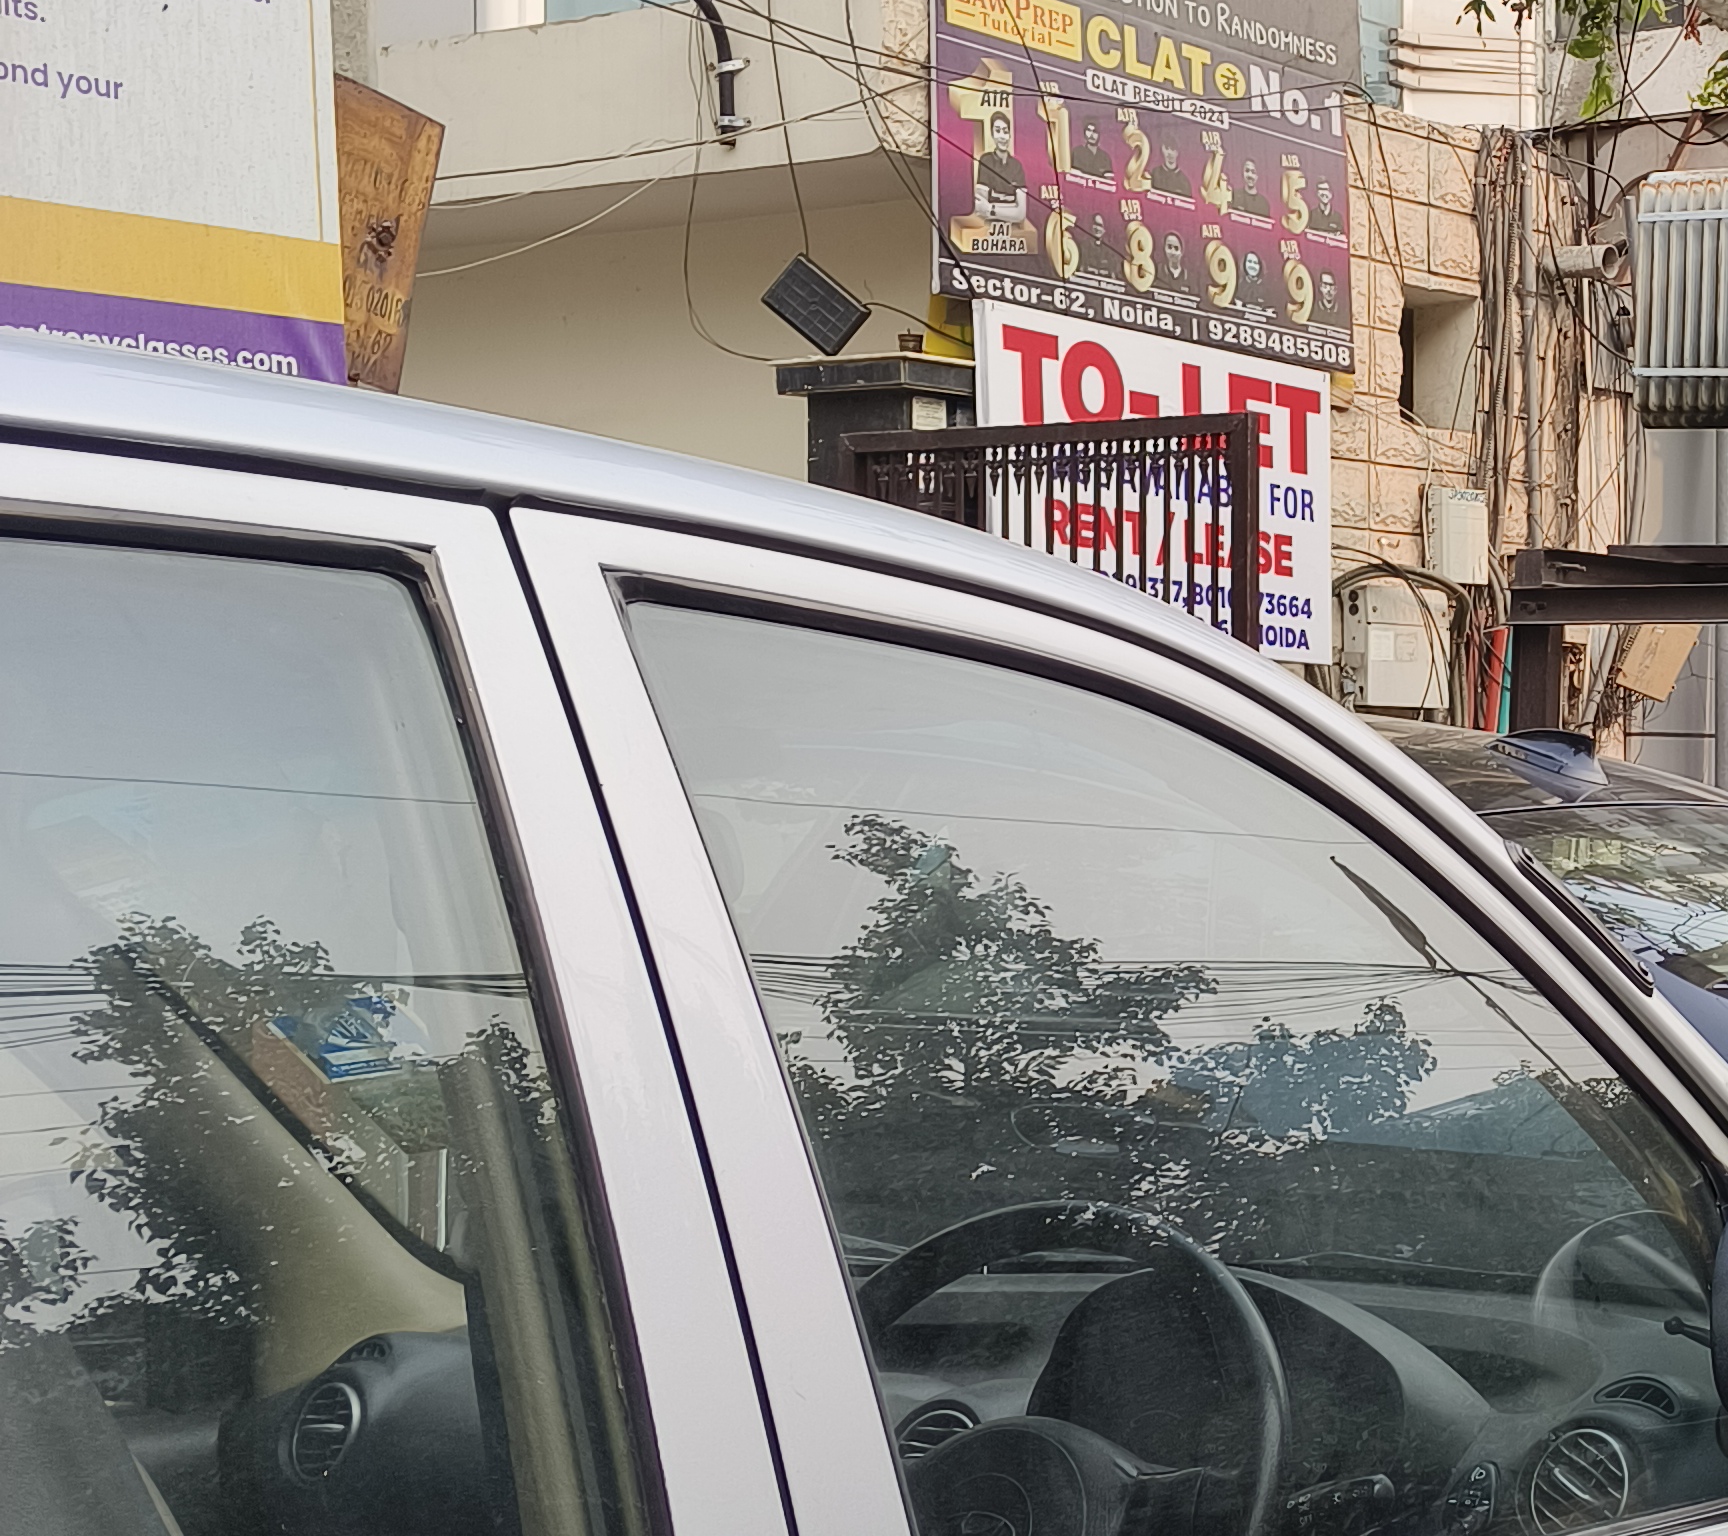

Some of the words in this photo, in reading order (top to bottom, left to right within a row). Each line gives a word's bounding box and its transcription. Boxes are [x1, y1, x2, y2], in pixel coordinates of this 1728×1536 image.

[979, 11, 1053, 47] Tutorial
[1185, 0, 1211, 28] TO
[1216, 2, 1337, 65] RANDOMNESS
[1086, 15, 1211, 96] CLAT
[56, 71, 123, 100] your
[980, 89, 1011, 108] AIR
[1091, 73, 1128, 97] CLAT
[1133, 84, 1184, 114] RESULT
[1189, 102, 1225, 126] 2024
[1117, 107, 1139, 125] AIR
[1202, 130, 1222, 146] AIR
[1281, 153, 1301, 168] AIR
[1121, 199, 1142, 215] AIR
[989, 223, 1011, 237] JAI
[1202, 224, 1223, 238] AIR
[972, 238, 1026, 253] BOHARA
[1281, 239, 1301, 254] AIR
[951, 267, 1095, 319] Sector-62,
[1103, 299, 1182, 337] Noida,
[1208, 318, 1351, 367] 9289485508
[1269, 483, 1315, 523] FOR
